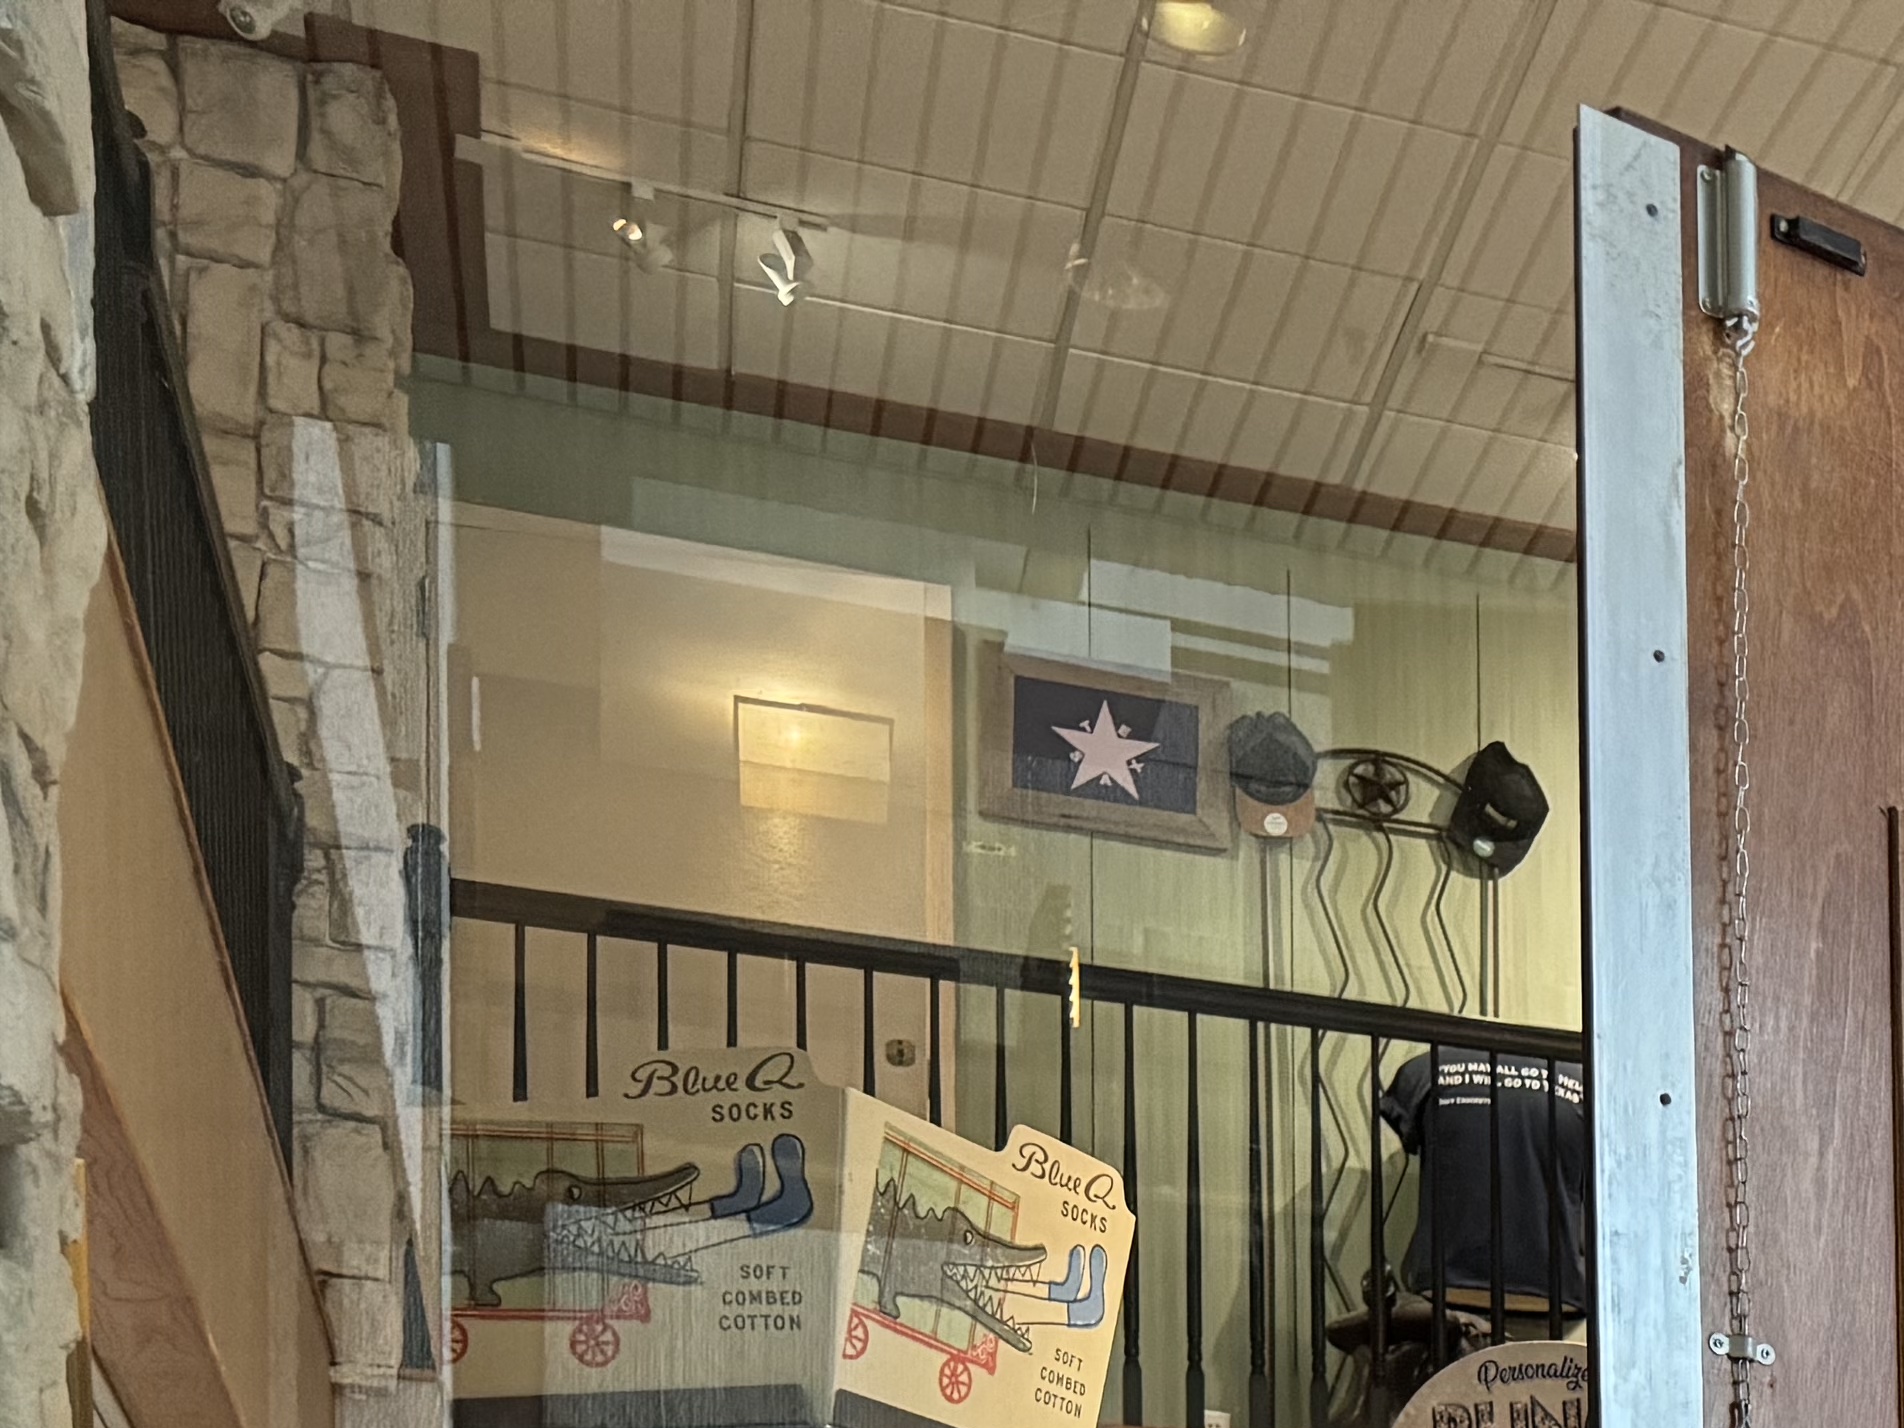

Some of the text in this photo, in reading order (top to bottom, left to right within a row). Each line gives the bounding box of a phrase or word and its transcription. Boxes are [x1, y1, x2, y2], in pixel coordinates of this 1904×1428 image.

[623, 1051, 806, 1100] Blue Q
[1438, 1074, 1463, 1086] AND
[710, 1100, 794, 1124] SOCKS
[1011, 1141, 1117, 1211] Blue Q
[1060, 1199, 1109, 1235] SOCKS
[739, 1263, 789, 1281] SOFT
[721, 1289, 803, 1307] COMBED
[718, 1314, 802, 1332] COTTON
[1053, 1347, 1084, 1372] SOFT
[1039, 1366, 1087, 1397] COMBED
[1033, 1387, 1084, 1419] COTTON
